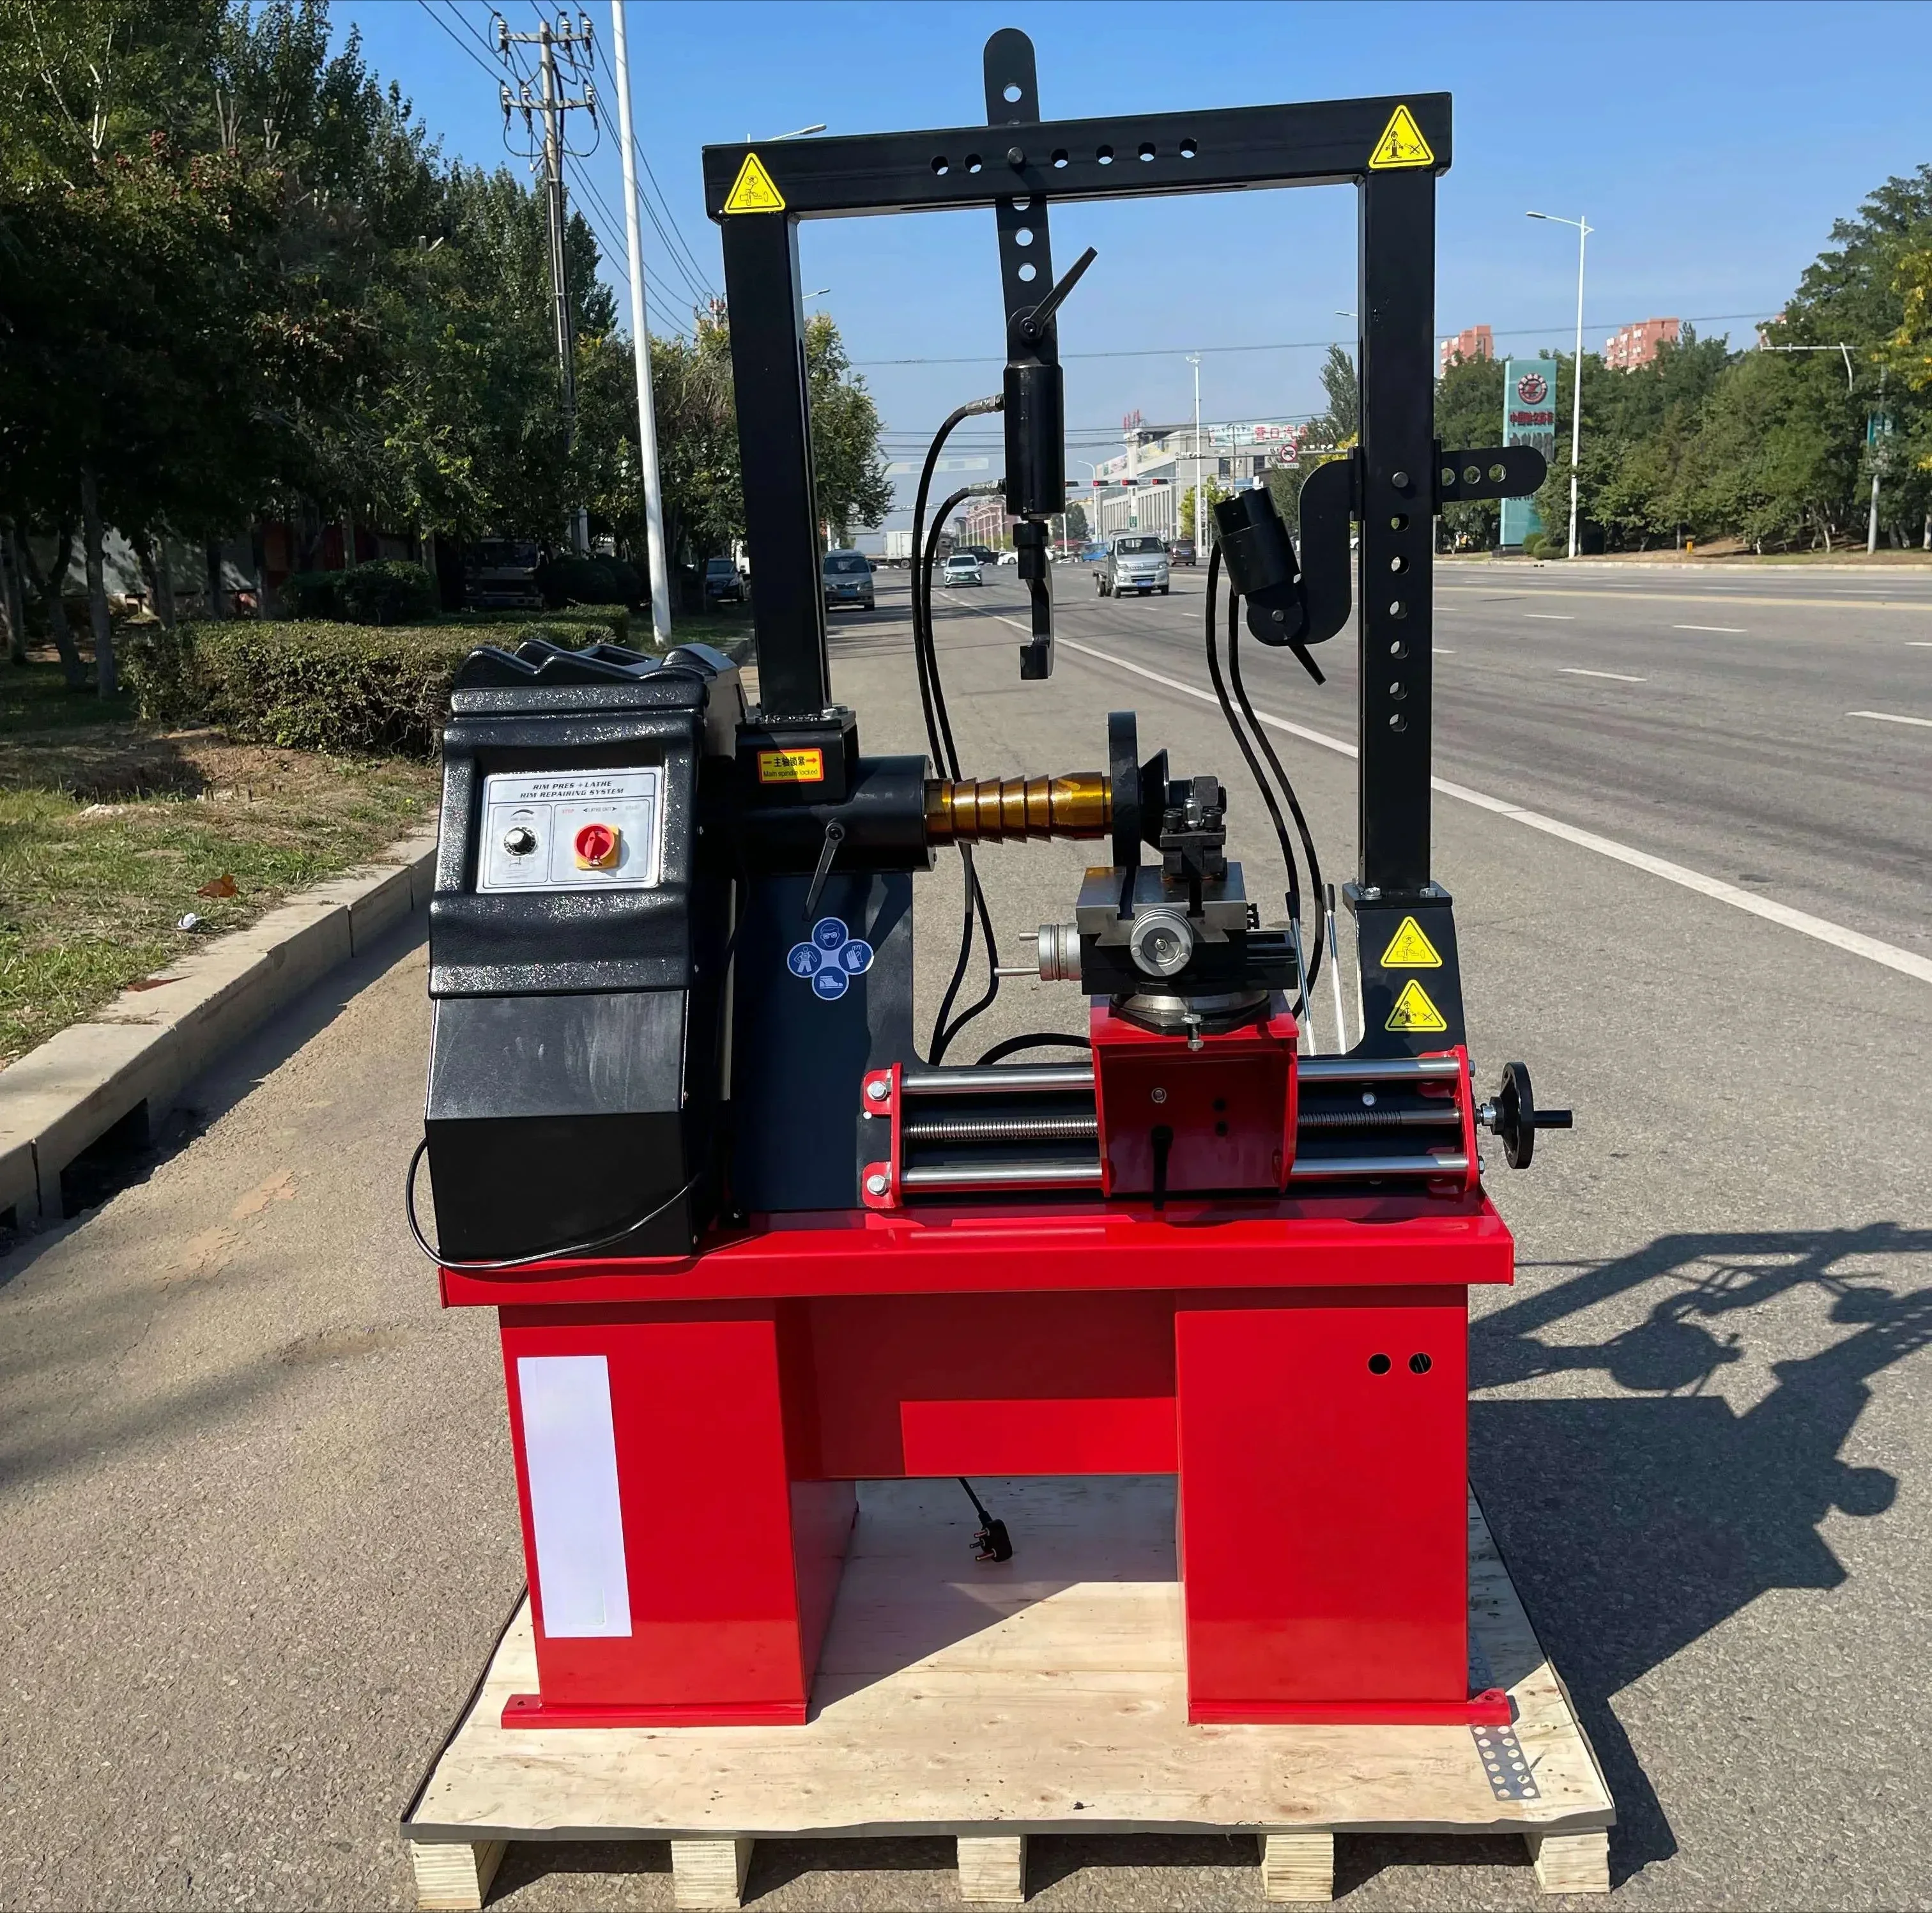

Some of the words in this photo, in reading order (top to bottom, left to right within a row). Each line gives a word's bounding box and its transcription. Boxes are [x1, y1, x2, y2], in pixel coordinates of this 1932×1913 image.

[774, 756, 805, 767] 主轴锁紧
[539, 789, 586, 797] REPAIRING
